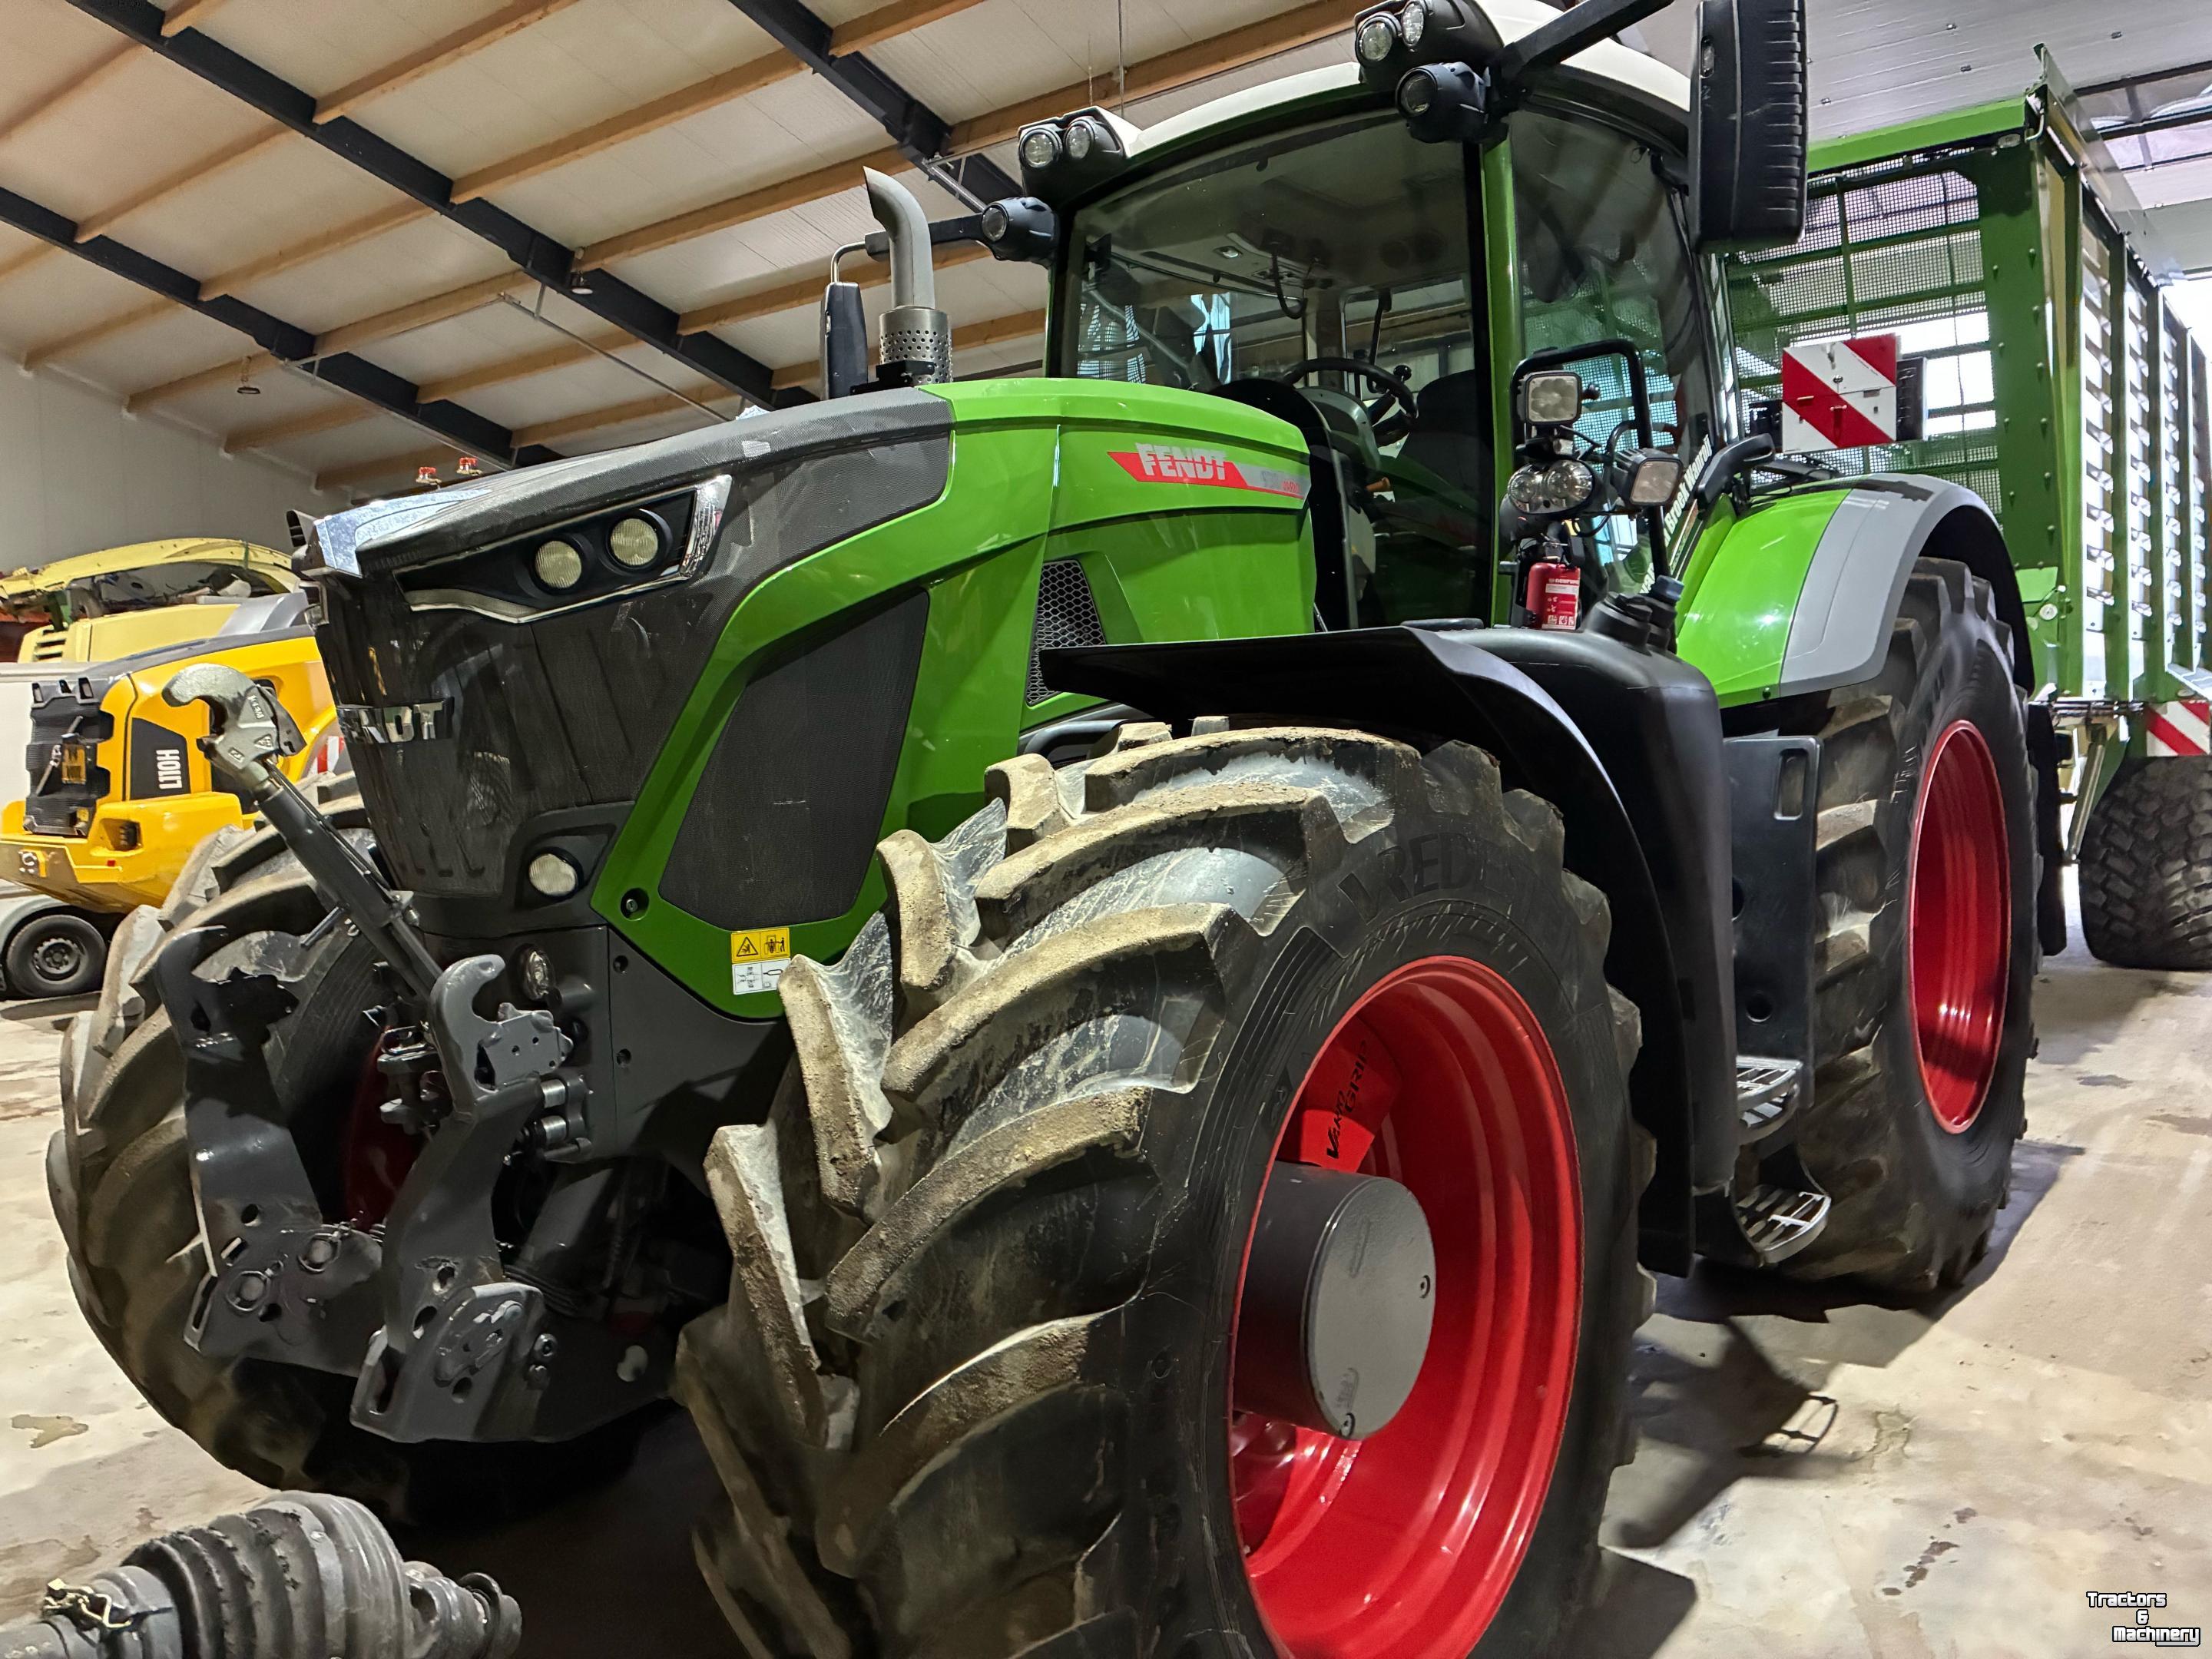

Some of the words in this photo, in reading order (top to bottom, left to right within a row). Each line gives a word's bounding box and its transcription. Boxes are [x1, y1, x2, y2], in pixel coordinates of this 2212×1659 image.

[1135, 442, 1228, 481] FENDT
[1664, 482, 1690, 536] Broek
[156, 749, 183, 790] L110H
